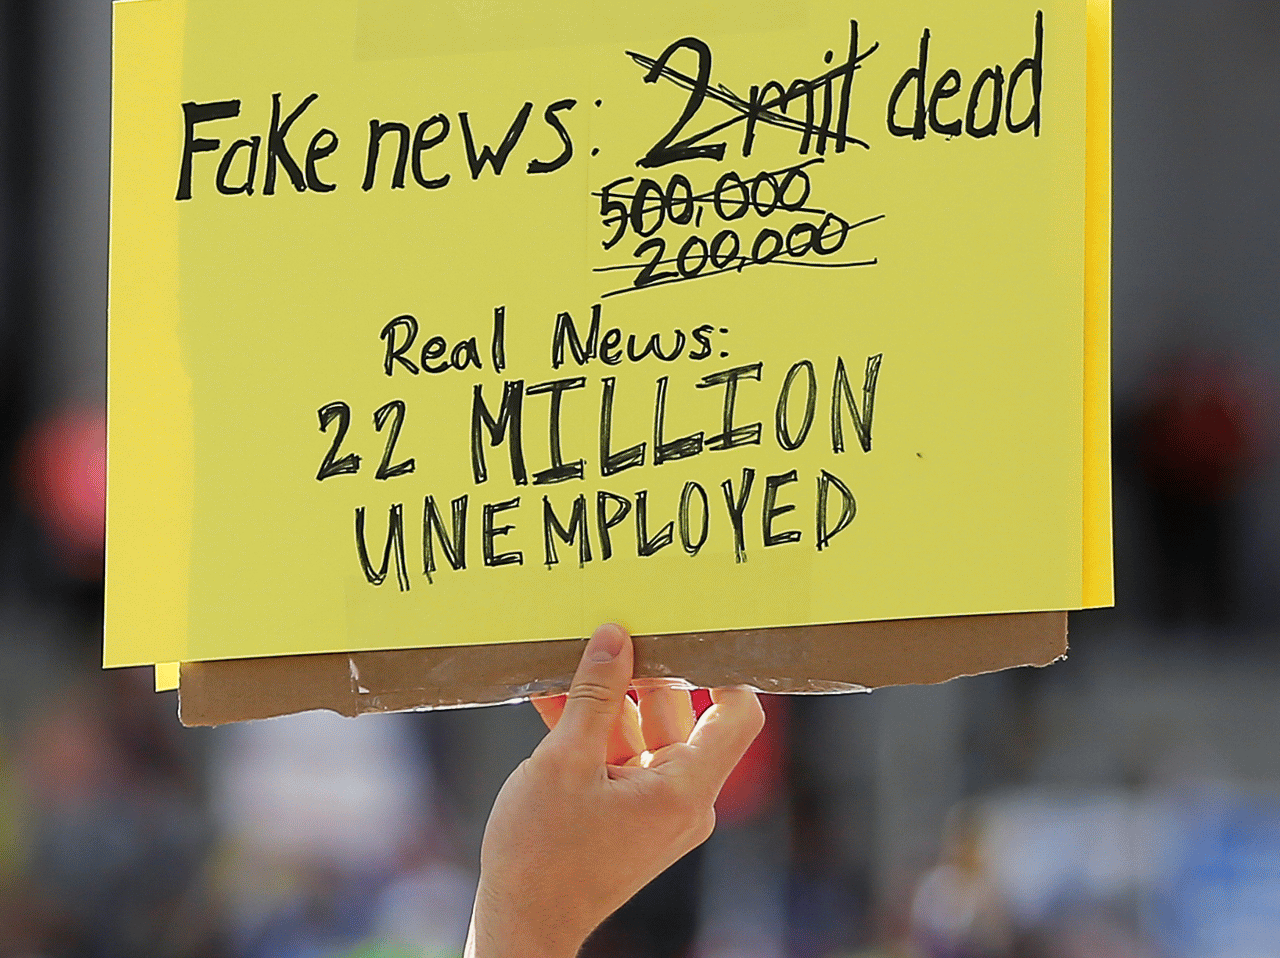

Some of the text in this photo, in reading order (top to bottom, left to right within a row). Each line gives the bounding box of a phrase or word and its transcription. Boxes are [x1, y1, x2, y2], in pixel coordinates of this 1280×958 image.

[362, 99, 603, 192] news:
[636, 36, 727, 168] 2
[886, 9, 1043, 141] dead
[598, 168, 810, 250] 500,000
[633, 213, 849, 288] 200,000
[379, 303, 730, 377] Real News:
[315, 352, 883, 486] 22 MILLION
[355, 467, 858, 592] UNEMPLOYED
